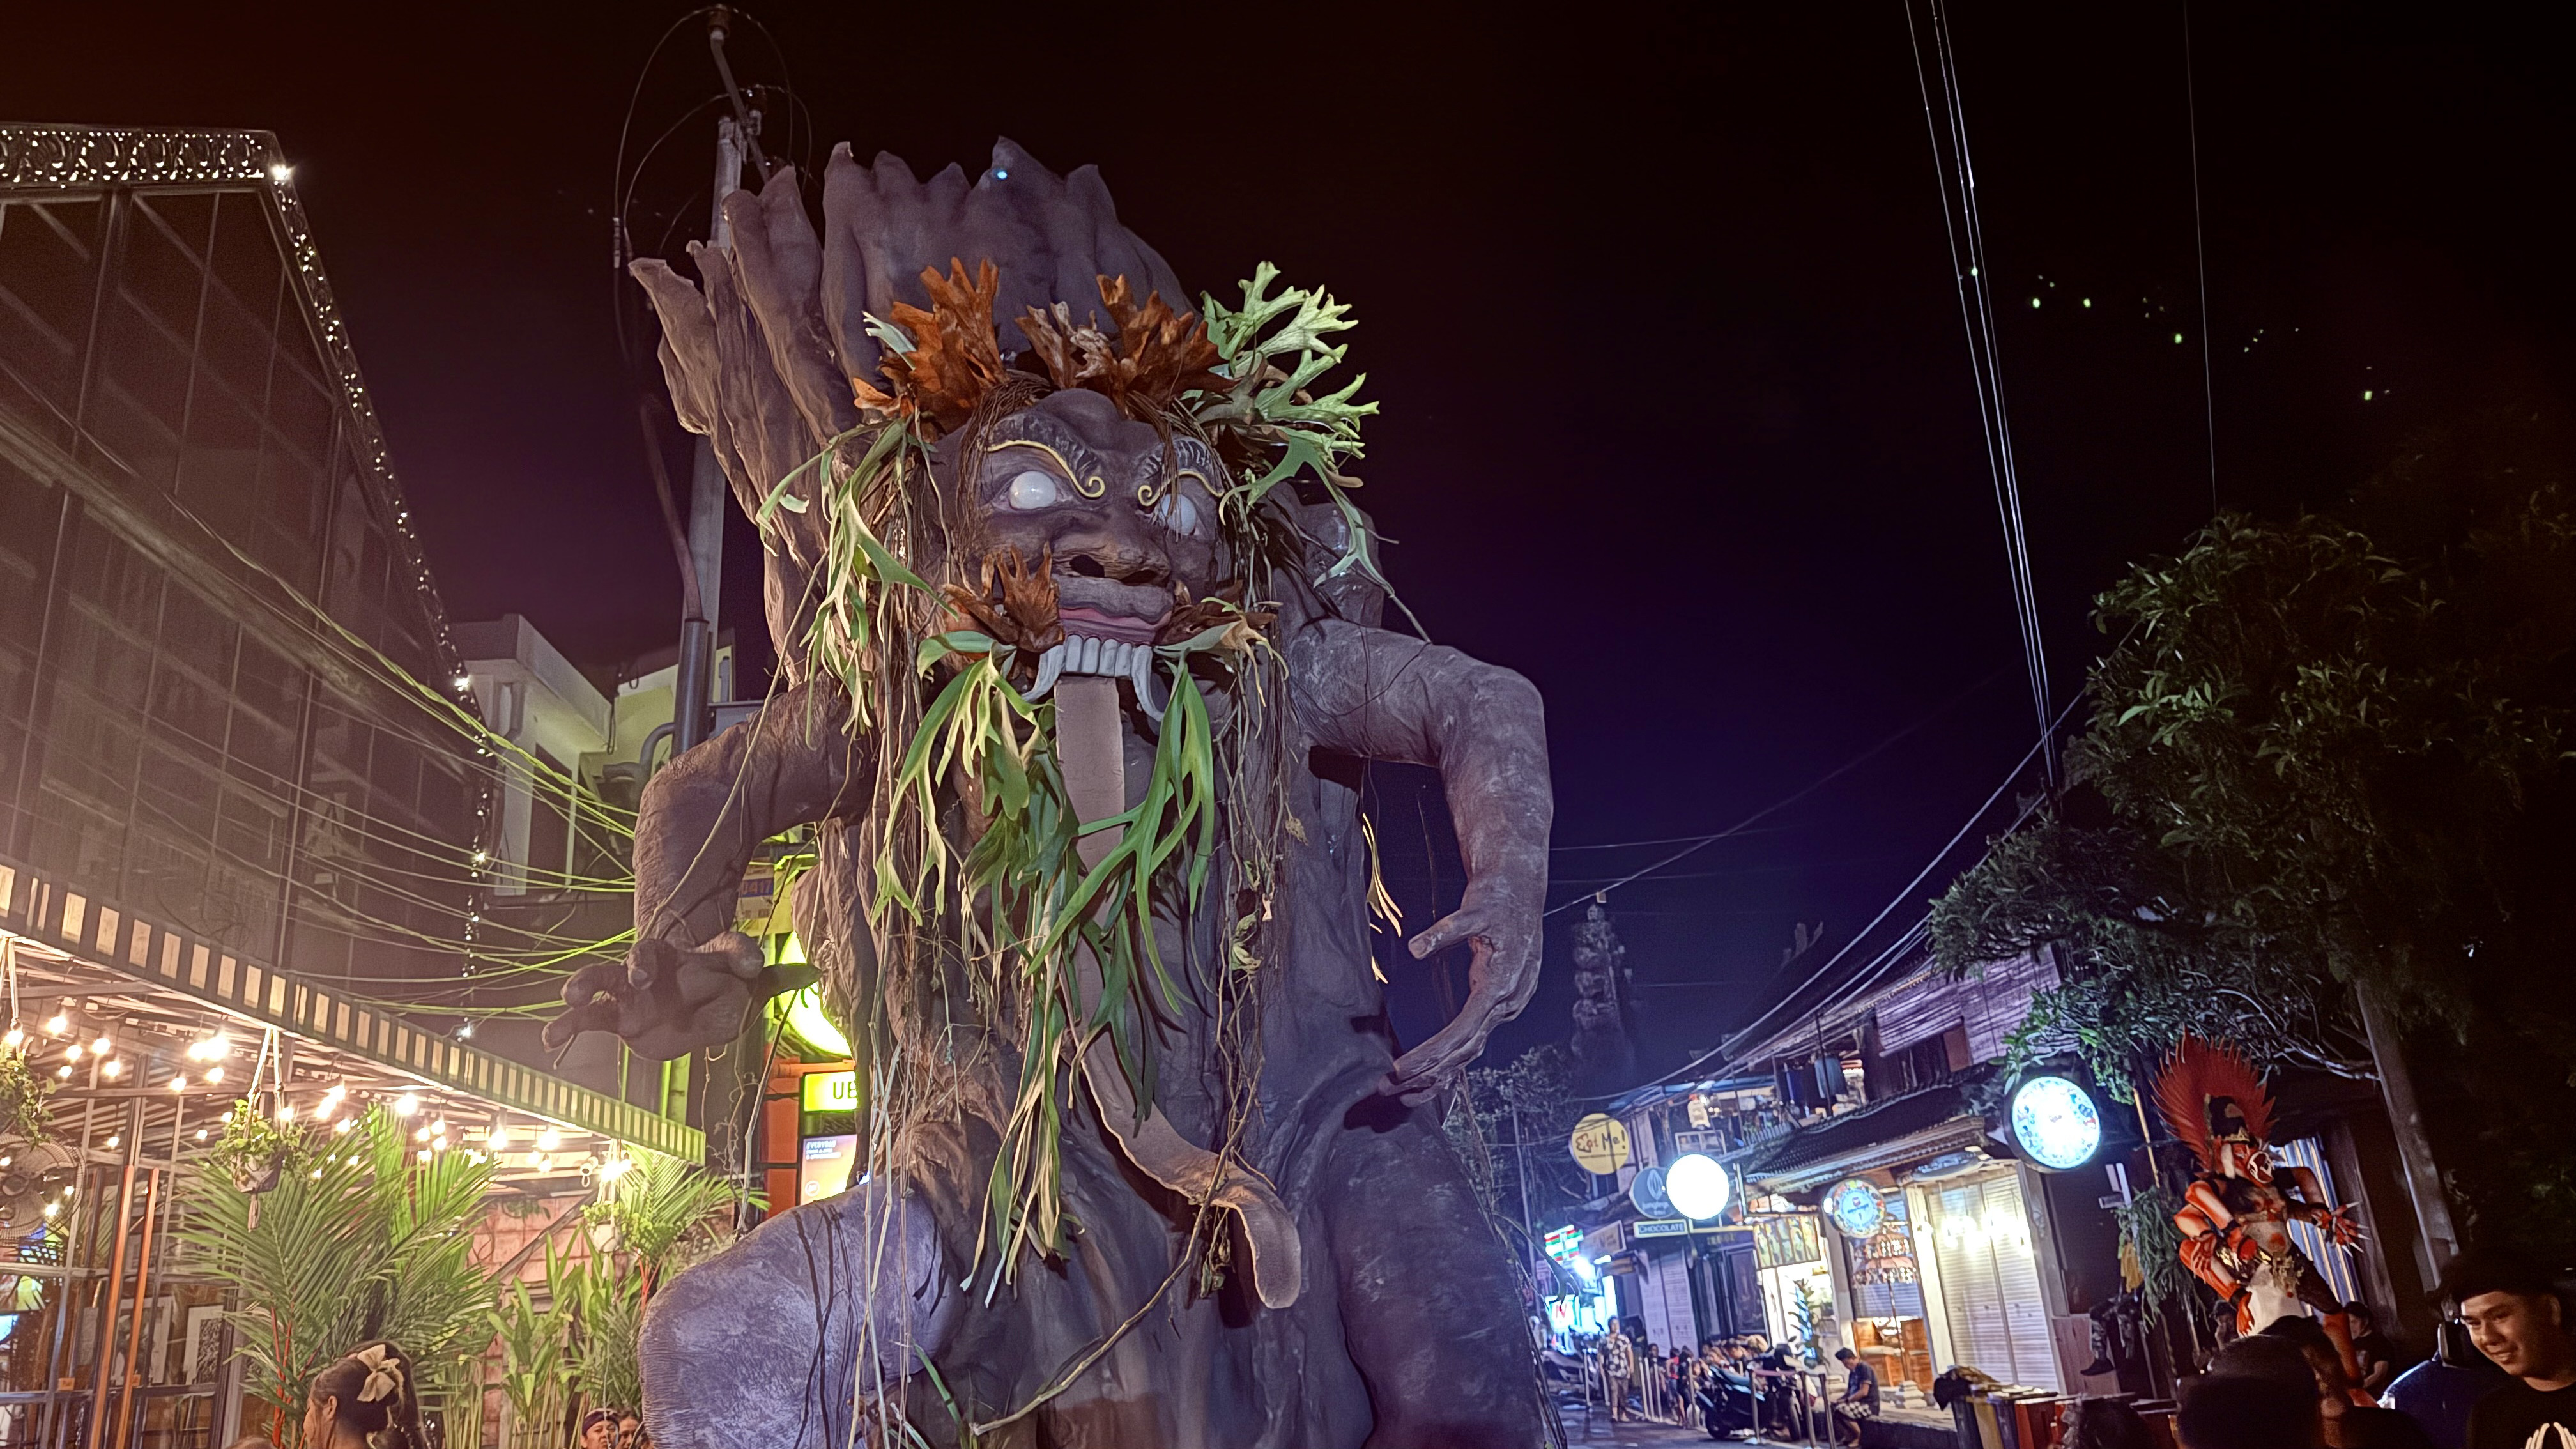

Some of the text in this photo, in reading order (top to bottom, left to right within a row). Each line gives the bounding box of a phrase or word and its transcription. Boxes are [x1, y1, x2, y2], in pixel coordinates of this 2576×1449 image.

[1575, 1130, 1626, 1153] Eat Me!
[1639, 1223, 1683, 1233] CHOCOLATE
